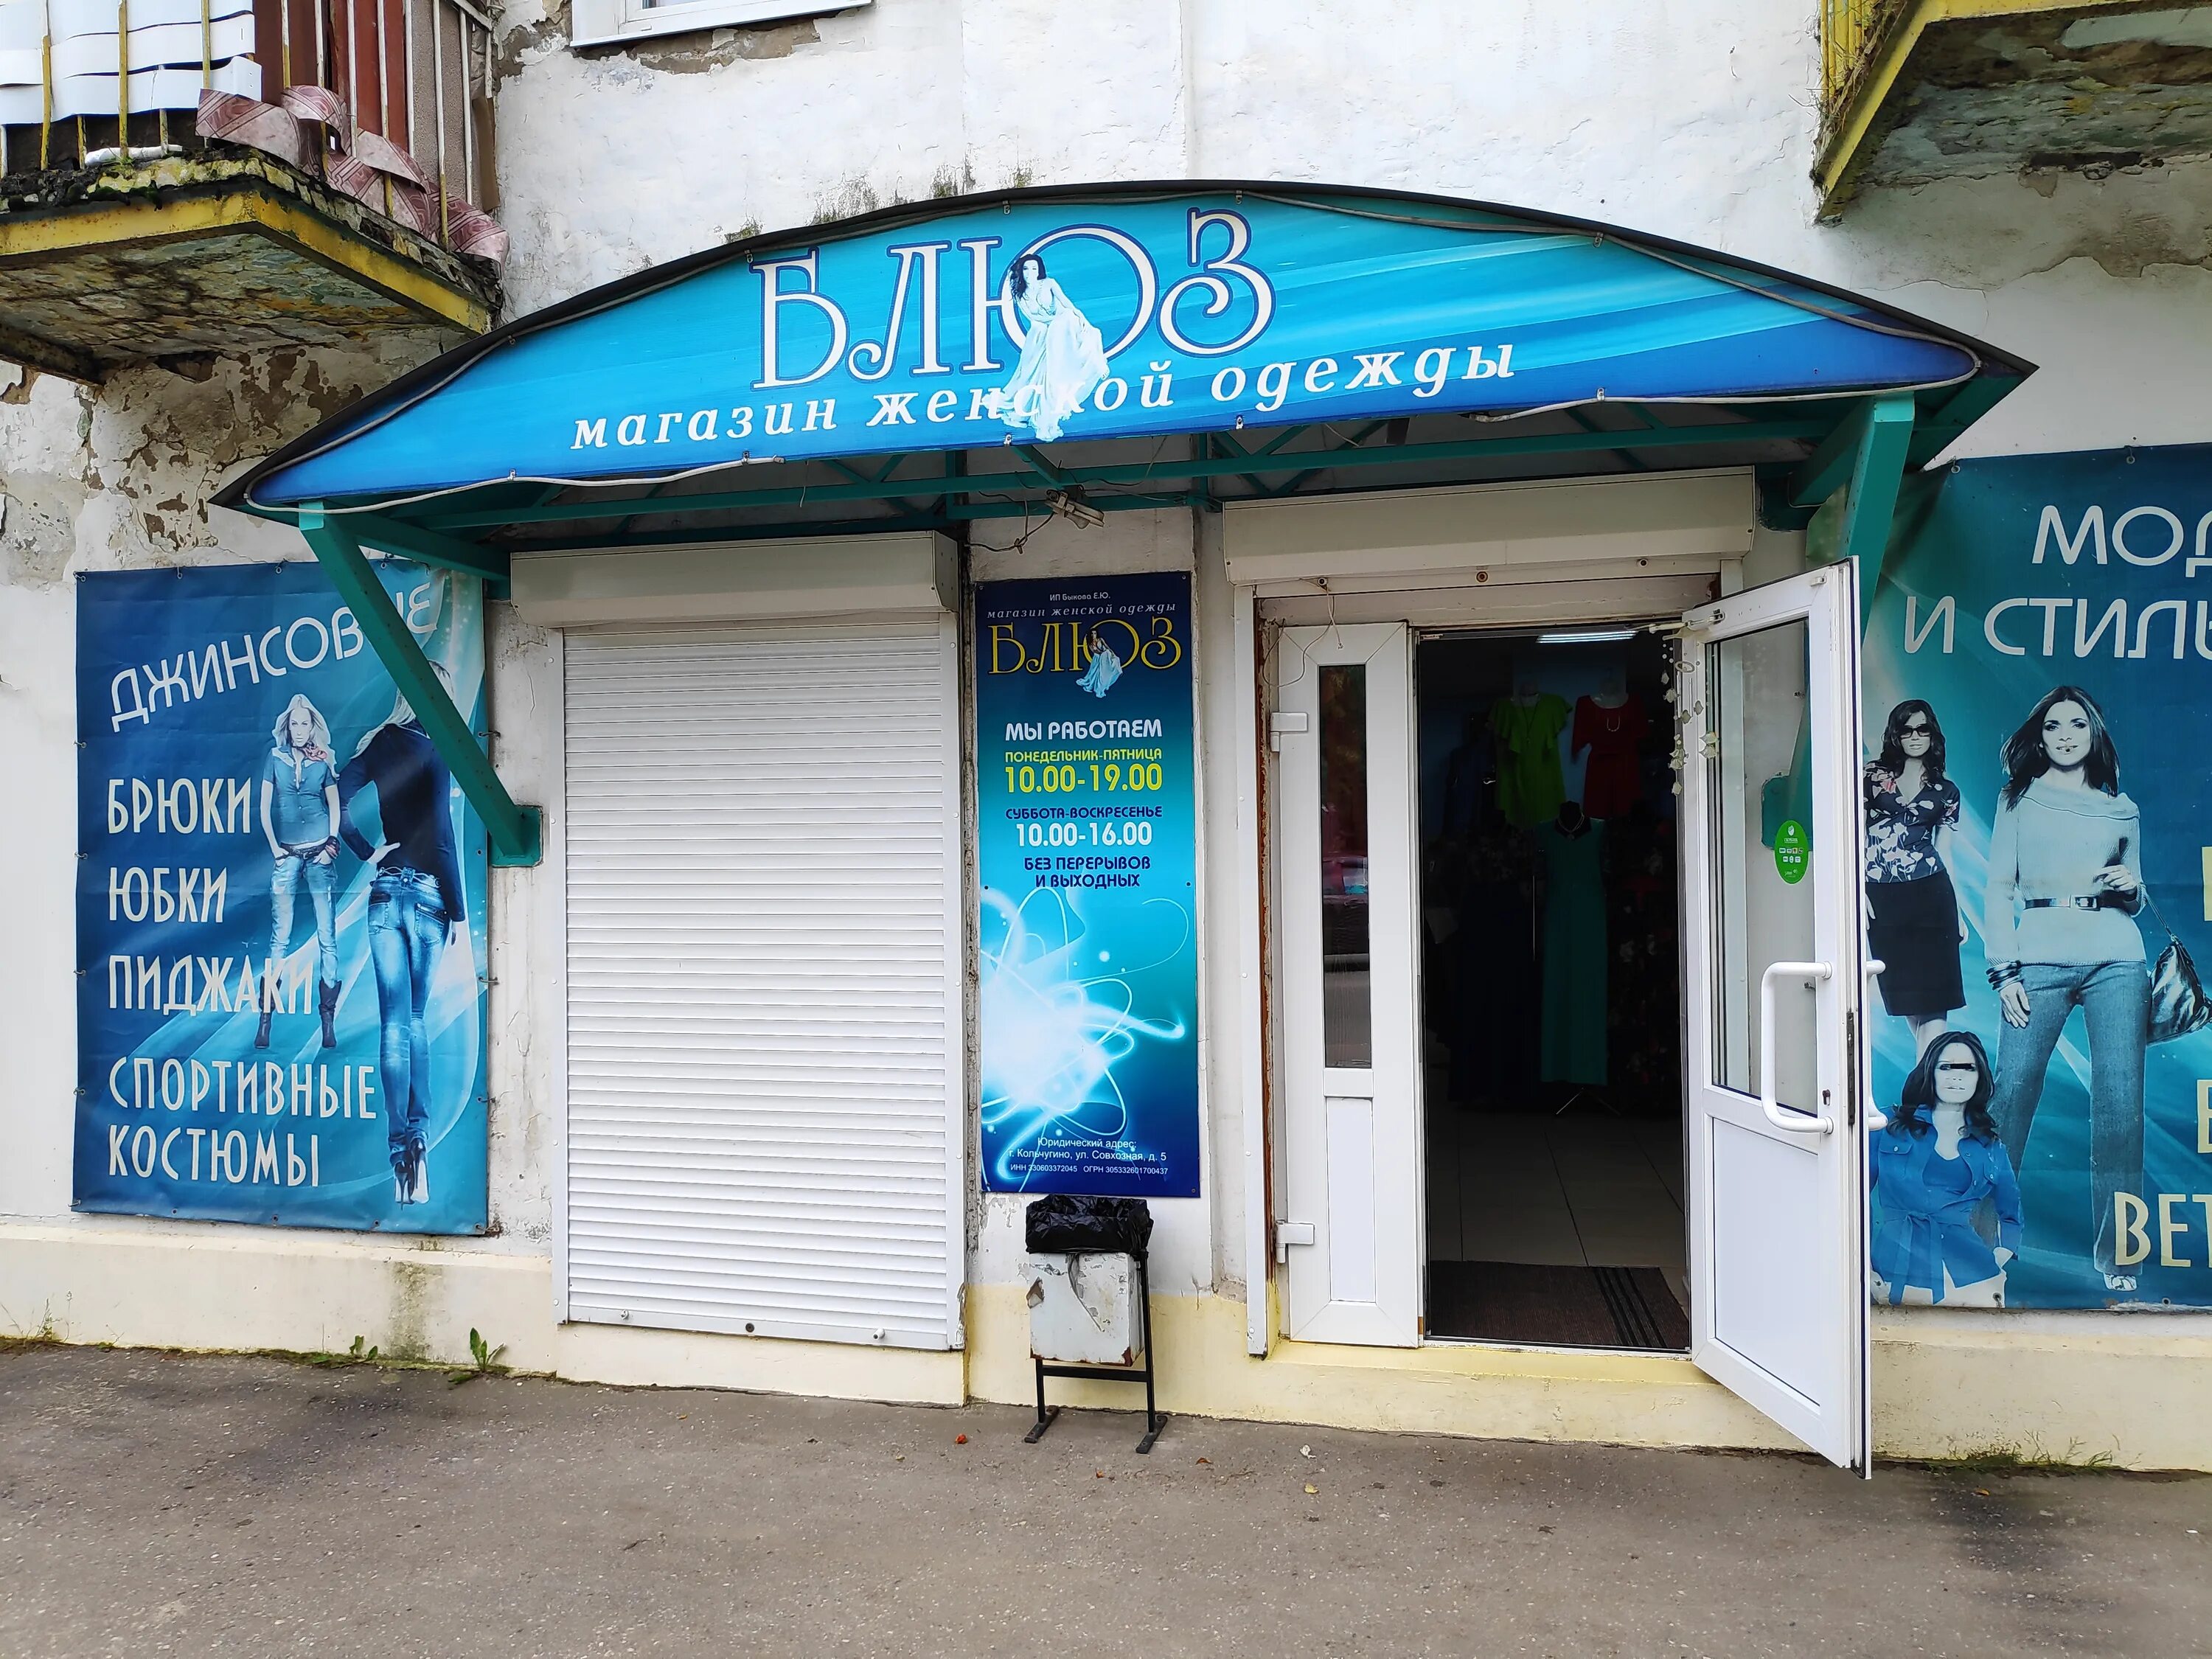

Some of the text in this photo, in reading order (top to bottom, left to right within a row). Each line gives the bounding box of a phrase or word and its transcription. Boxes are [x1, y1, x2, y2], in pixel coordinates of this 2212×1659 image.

[749, 208, 1277, 393] БЛЮЗ
[570, 344, 1515, 450] магазин женской одежды
[987, 602, 1176, 619] магазин женской одежды
[1049, 591, 1111, 602] ИП Быкова Е.Ю.
[1904, 595, 1955, 654] И
[110, 582, 438, 734] ДЖИНСОВЕ
[987, 616, 1181, 675] БЛЮЗ
[1005, 719, 1163, 741] МЫ РАБОТАЕМ
[1005, 748, 1162, 764] ПОНЕДЕЛЬНИК-ПЯТНИЦА
[1005, 763, 1163, 793] 10.00-19.00
[108, 778, 251, 834] БРЮКИ
[1005, 806, 1163, 820] СУББОТА-ВОСКРЕСЕНЬЕ
[1016, 821, 1152, 847] 10.00-16.00
[1024, 856, 1151, 871] БЕЗ ПЕРЕРЫВОВ
[109, 867, 227, 923] ЮБКИ
[1036, 873, 1141, 889] И ВЫХОДНЫХ
[109, 955, 314, 1017] ПИДЖАКИ
[109, 1056, 377, 1119] СПОРТИВНЫЕ
[109, 1124, 319, 1187] КОСТЮМЫ
[1018, 1149, 1073, 1160] Кольчугино,
[1075, 1151, 1089, 1161] ул.
[1091, 1150, 1146, 1161] Совхозная,
[1148, 1153, 1158, 1162] д.
[1161, 1152, 1167, 1161] 5
[1037, 1137, 1137, 1150] Юридический адрес:
